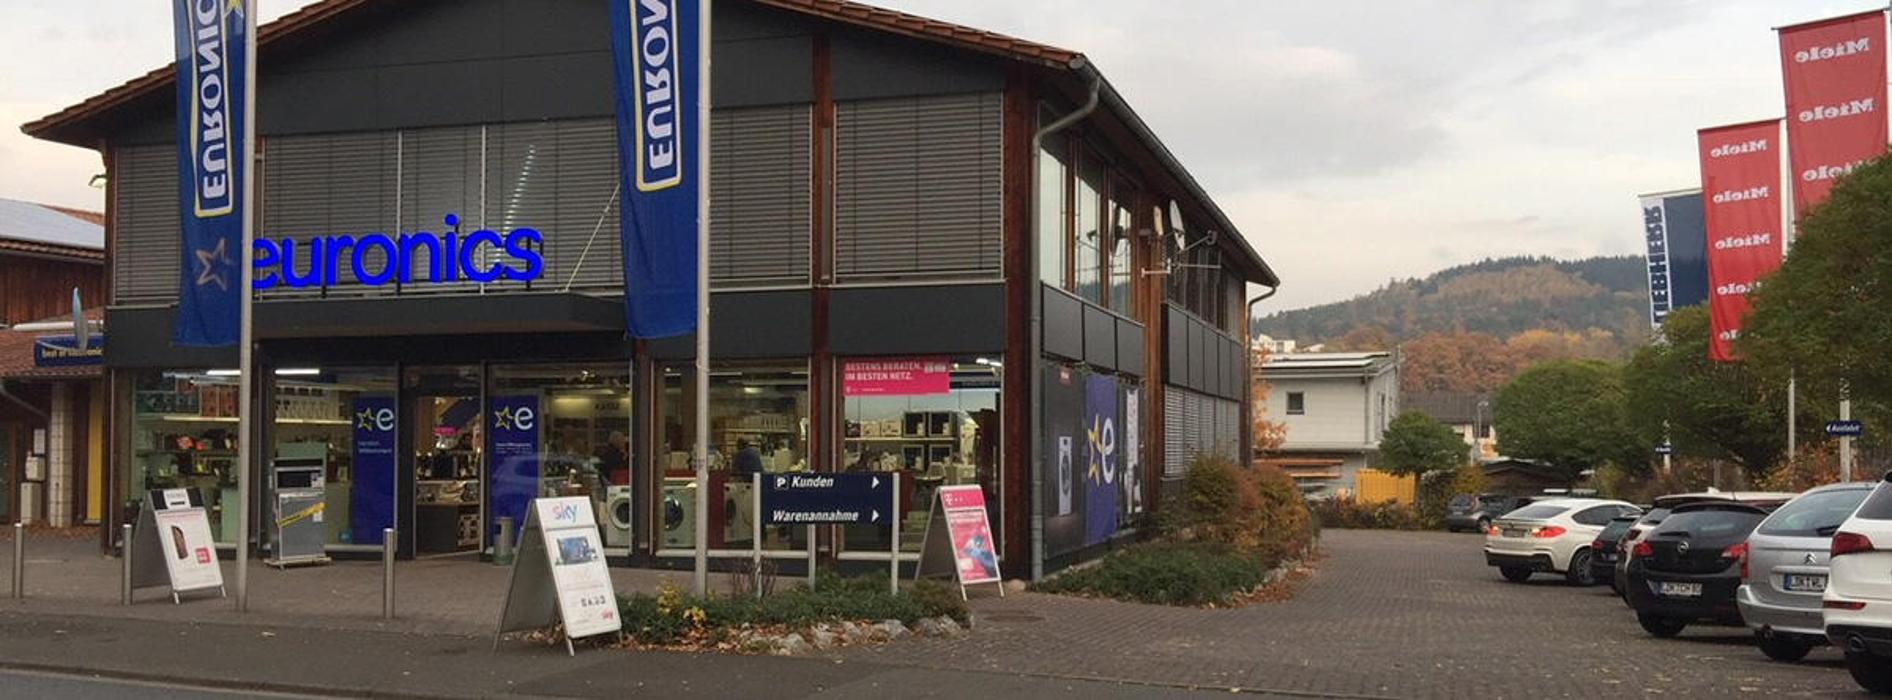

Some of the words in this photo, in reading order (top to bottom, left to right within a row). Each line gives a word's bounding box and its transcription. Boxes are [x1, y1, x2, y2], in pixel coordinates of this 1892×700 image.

[252, 213, 545, 289] euronics
[845, 362, 881, 371] BESTENS
[856, 372, 888, 380] BESTEN
[889, 371, 913, 380] NETZ.
[791, 475, 834, 488] Kunden
[552, 503, 578, 523] sky
[773, 509, 859, 522] Warenannahme
